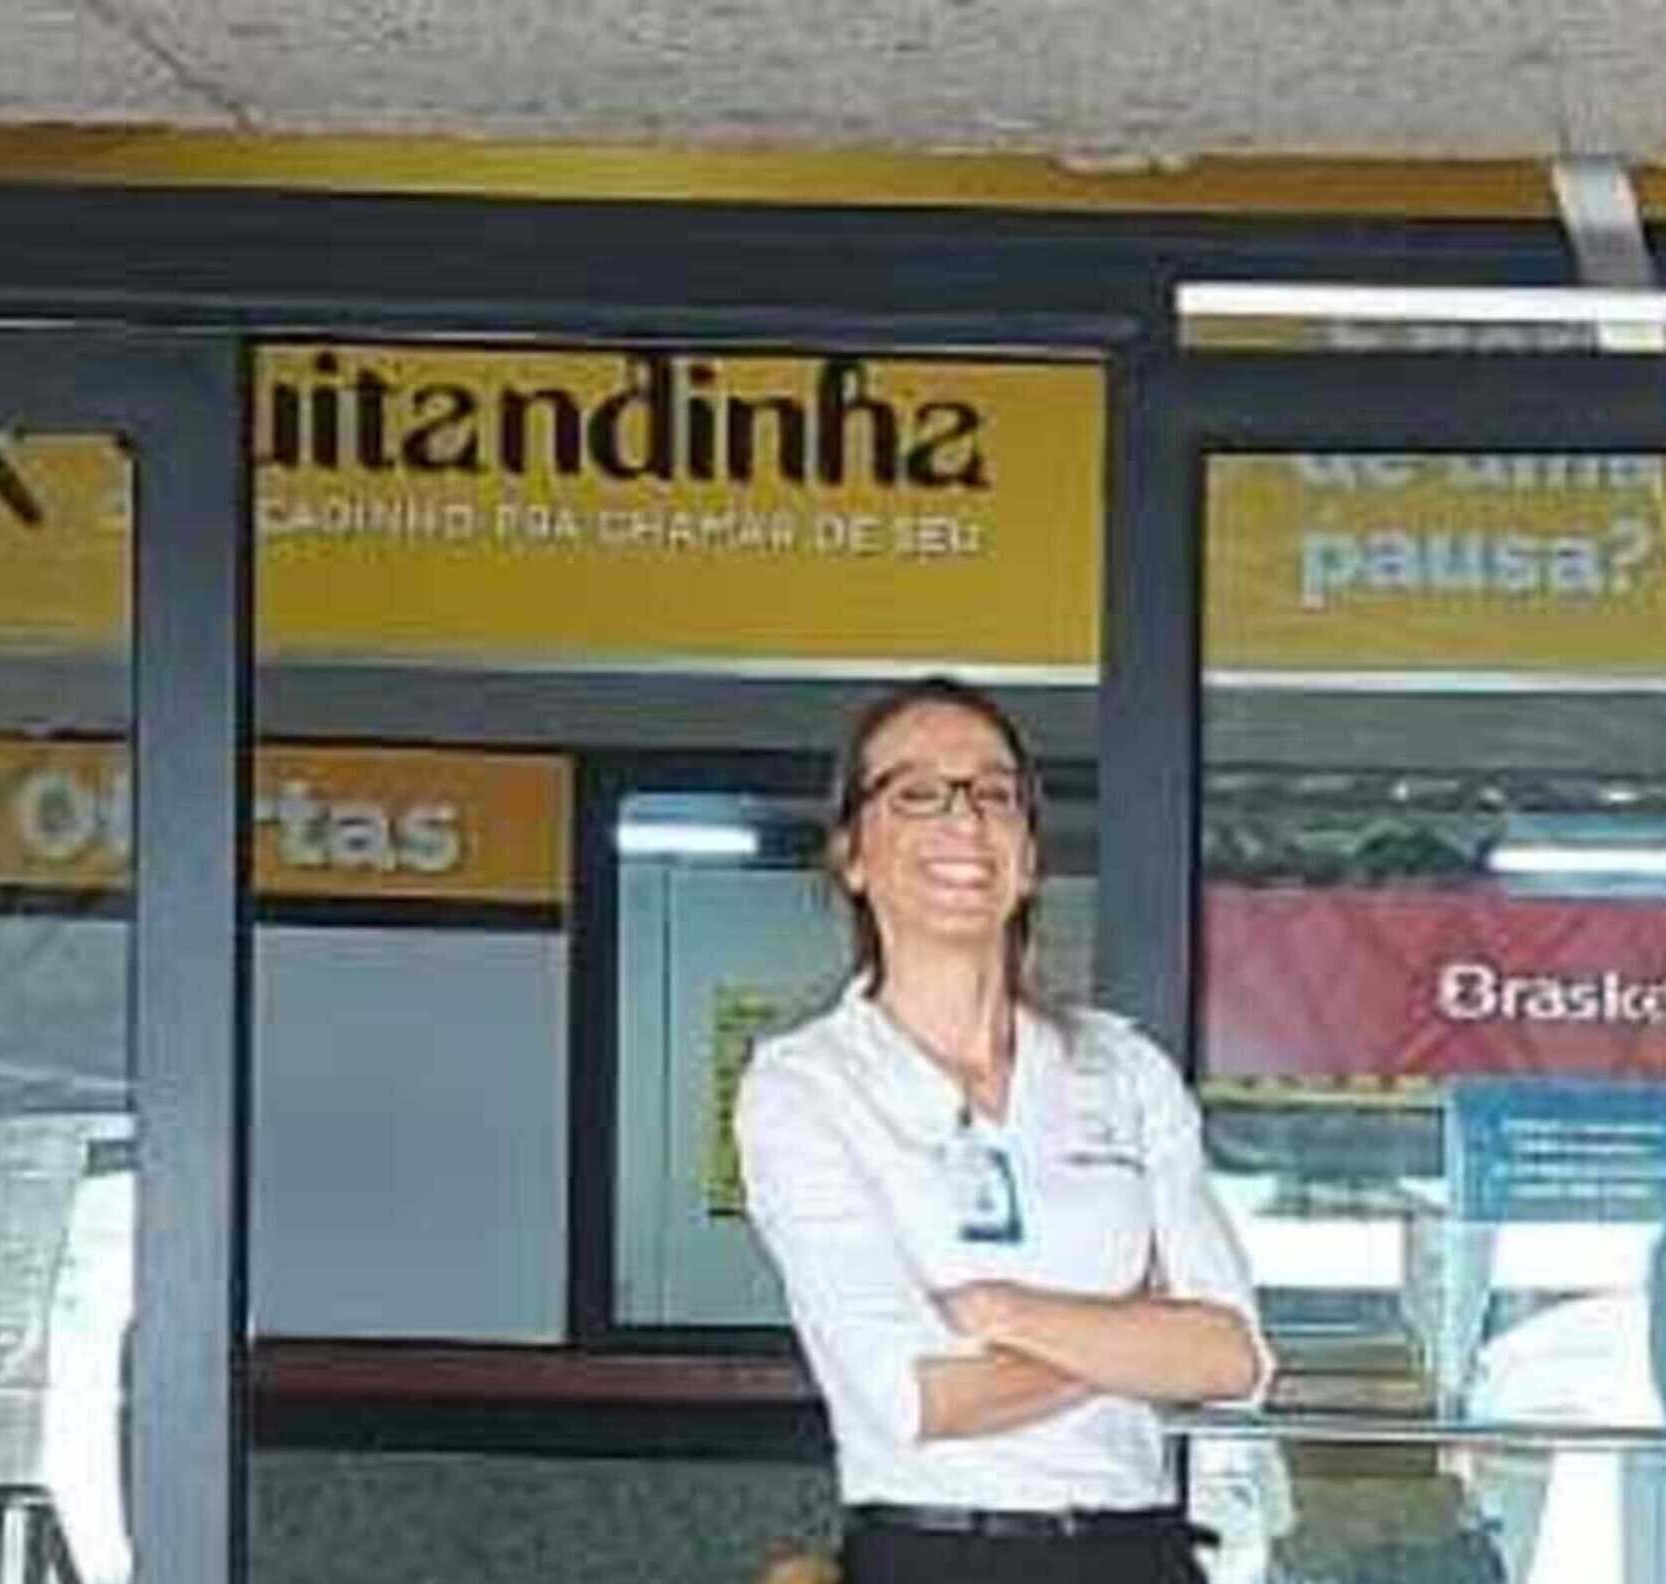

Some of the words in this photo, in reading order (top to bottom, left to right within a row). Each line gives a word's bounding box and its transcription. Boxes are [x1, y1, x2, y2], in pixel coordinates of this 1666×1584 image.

[252, 352, 990, 490] uitandinha
[254, 497, 476, 544] CADINHO
[1298, 514, 1652, 612] pausa?
